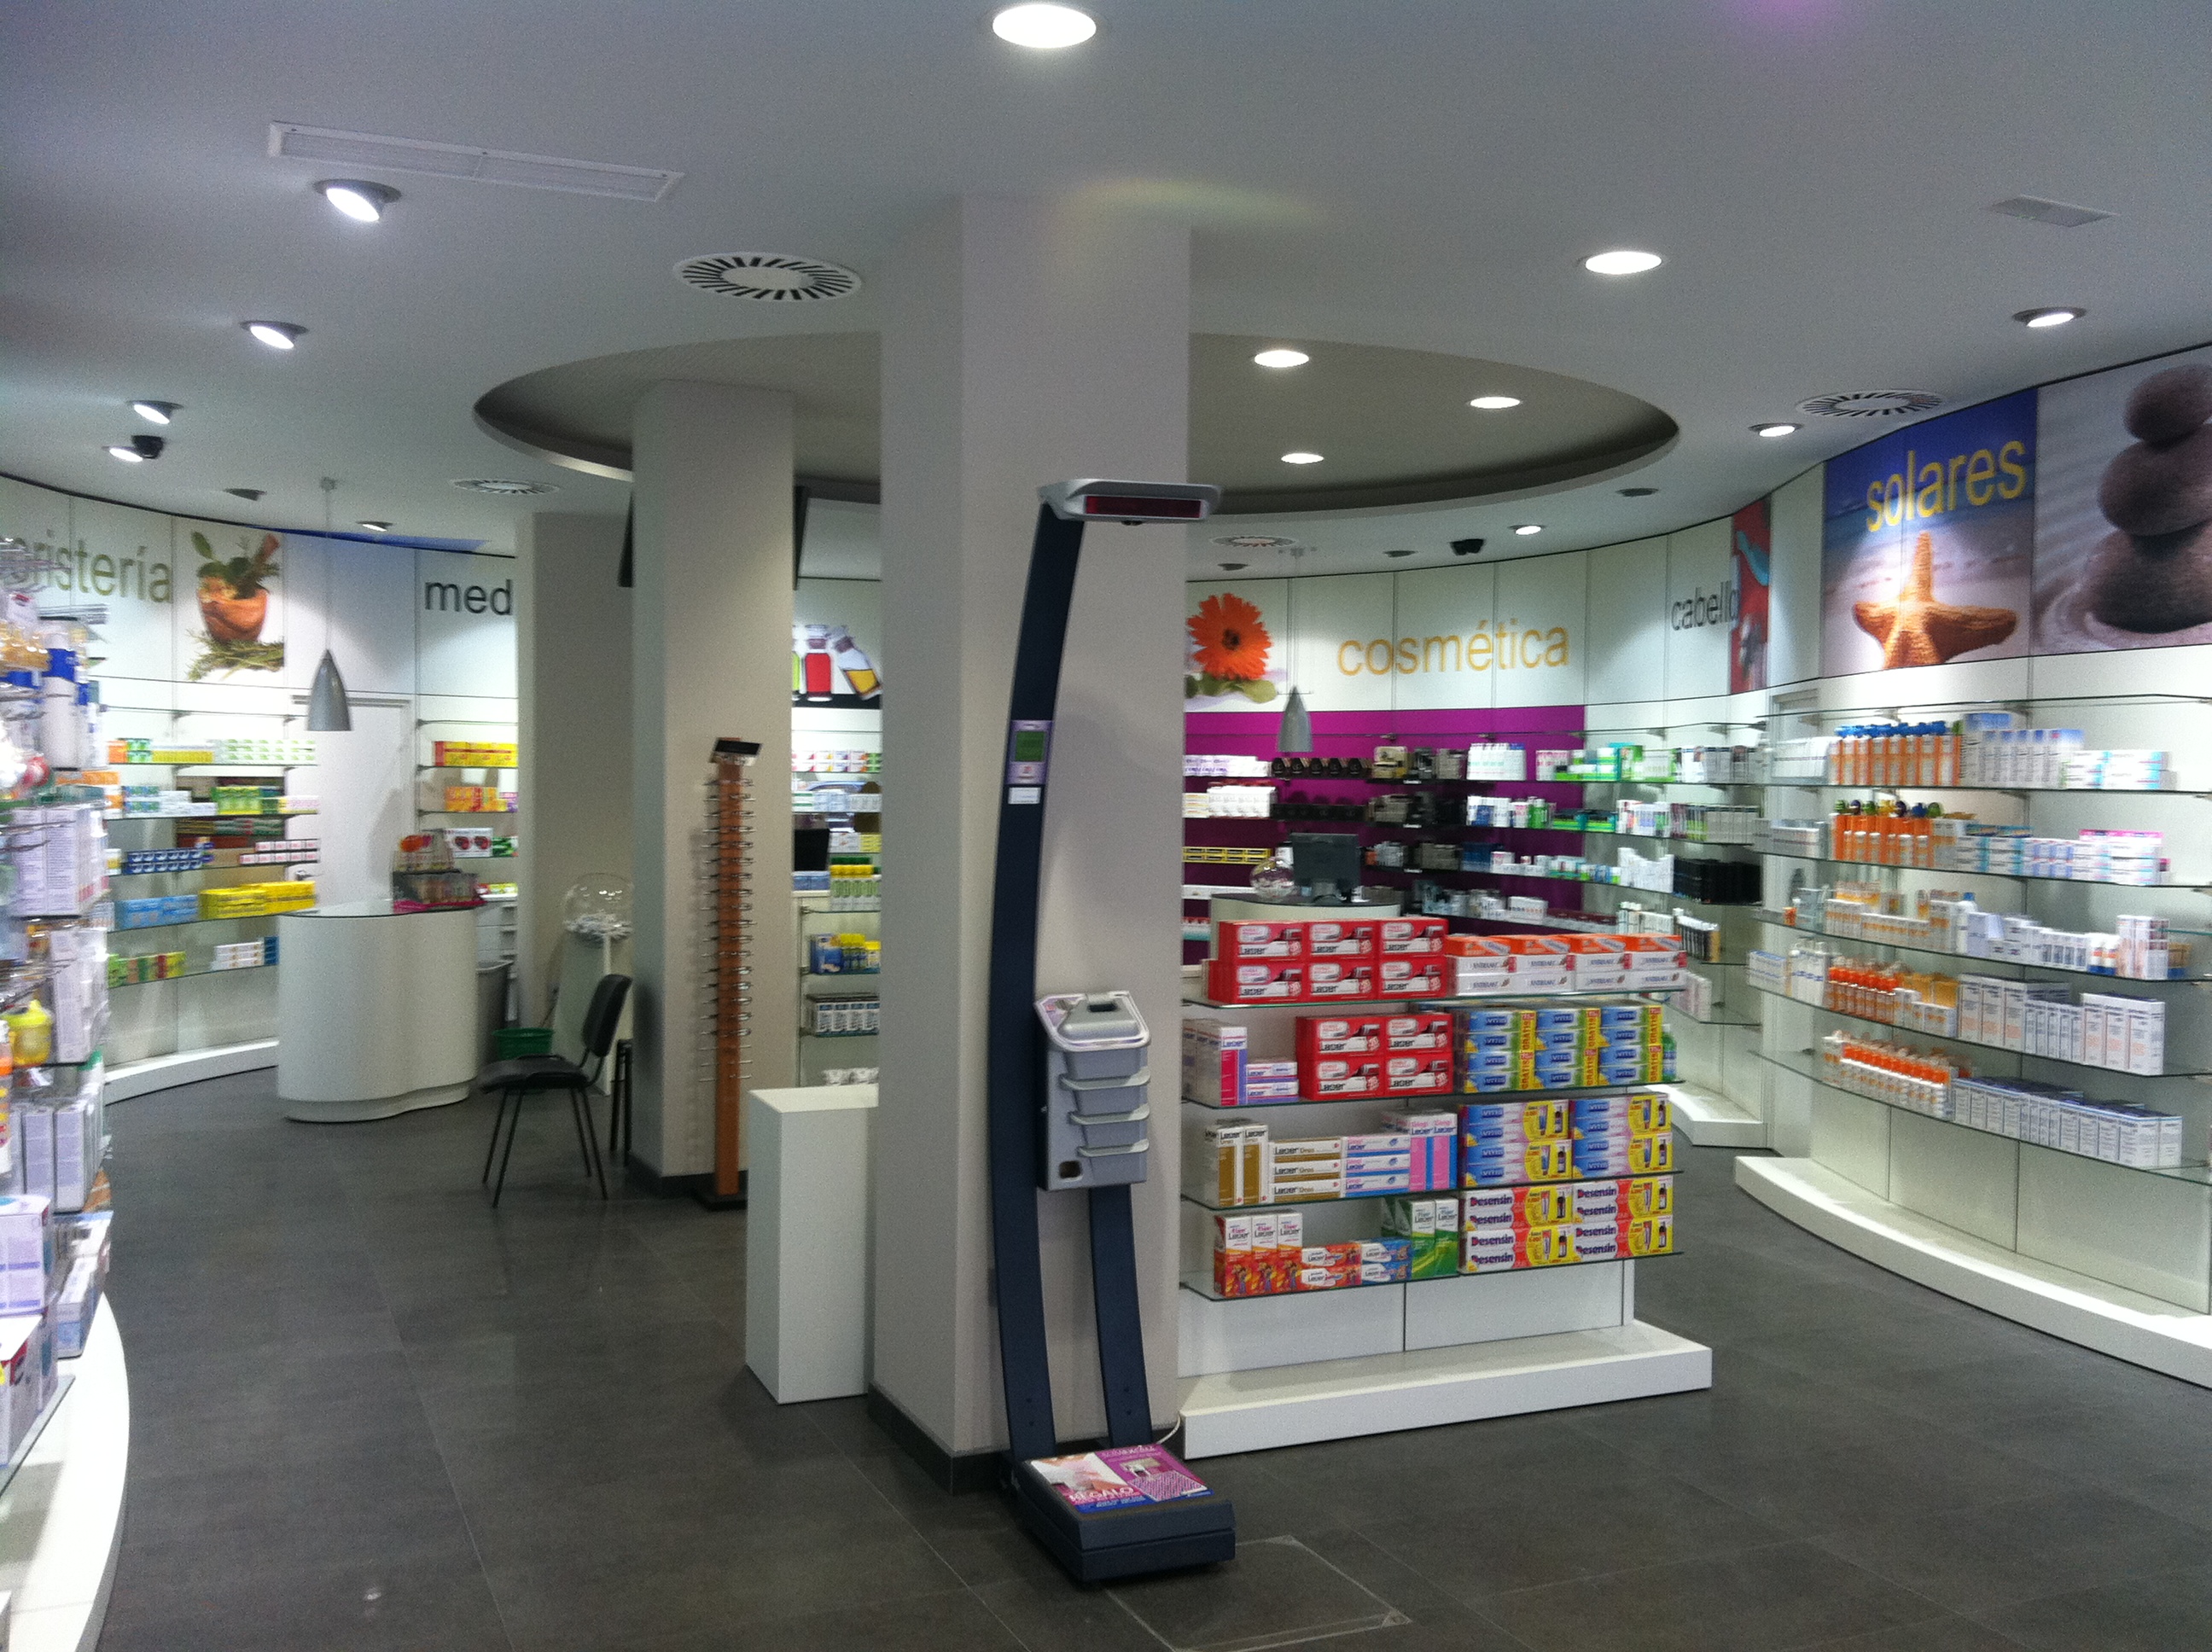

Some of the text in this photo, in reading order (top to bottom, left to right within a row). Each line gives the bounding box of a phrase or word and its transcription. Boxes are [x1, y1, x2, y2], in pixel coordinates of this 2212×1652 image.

[1866, 439, 2028, 532] solares
[424, 579, 513, 615] med
[1336, 619, 1570, 677] cosmética
[1577, 1186, 1617, 1199] Desensin
[1470, 1195, 1513, 1207] Desensin
[1577, 1204, 1617, 1216] Desensin
[1470, 1213, 1513, 1225] Desensin
[1576, 1224, 1617, 1237] Desensin
[1471, 1233, 1514, 1247] Desensin
[1575, 1242, 1616, 1255] Desensin
[1471, 1253, 1514, 1265] Desensin
